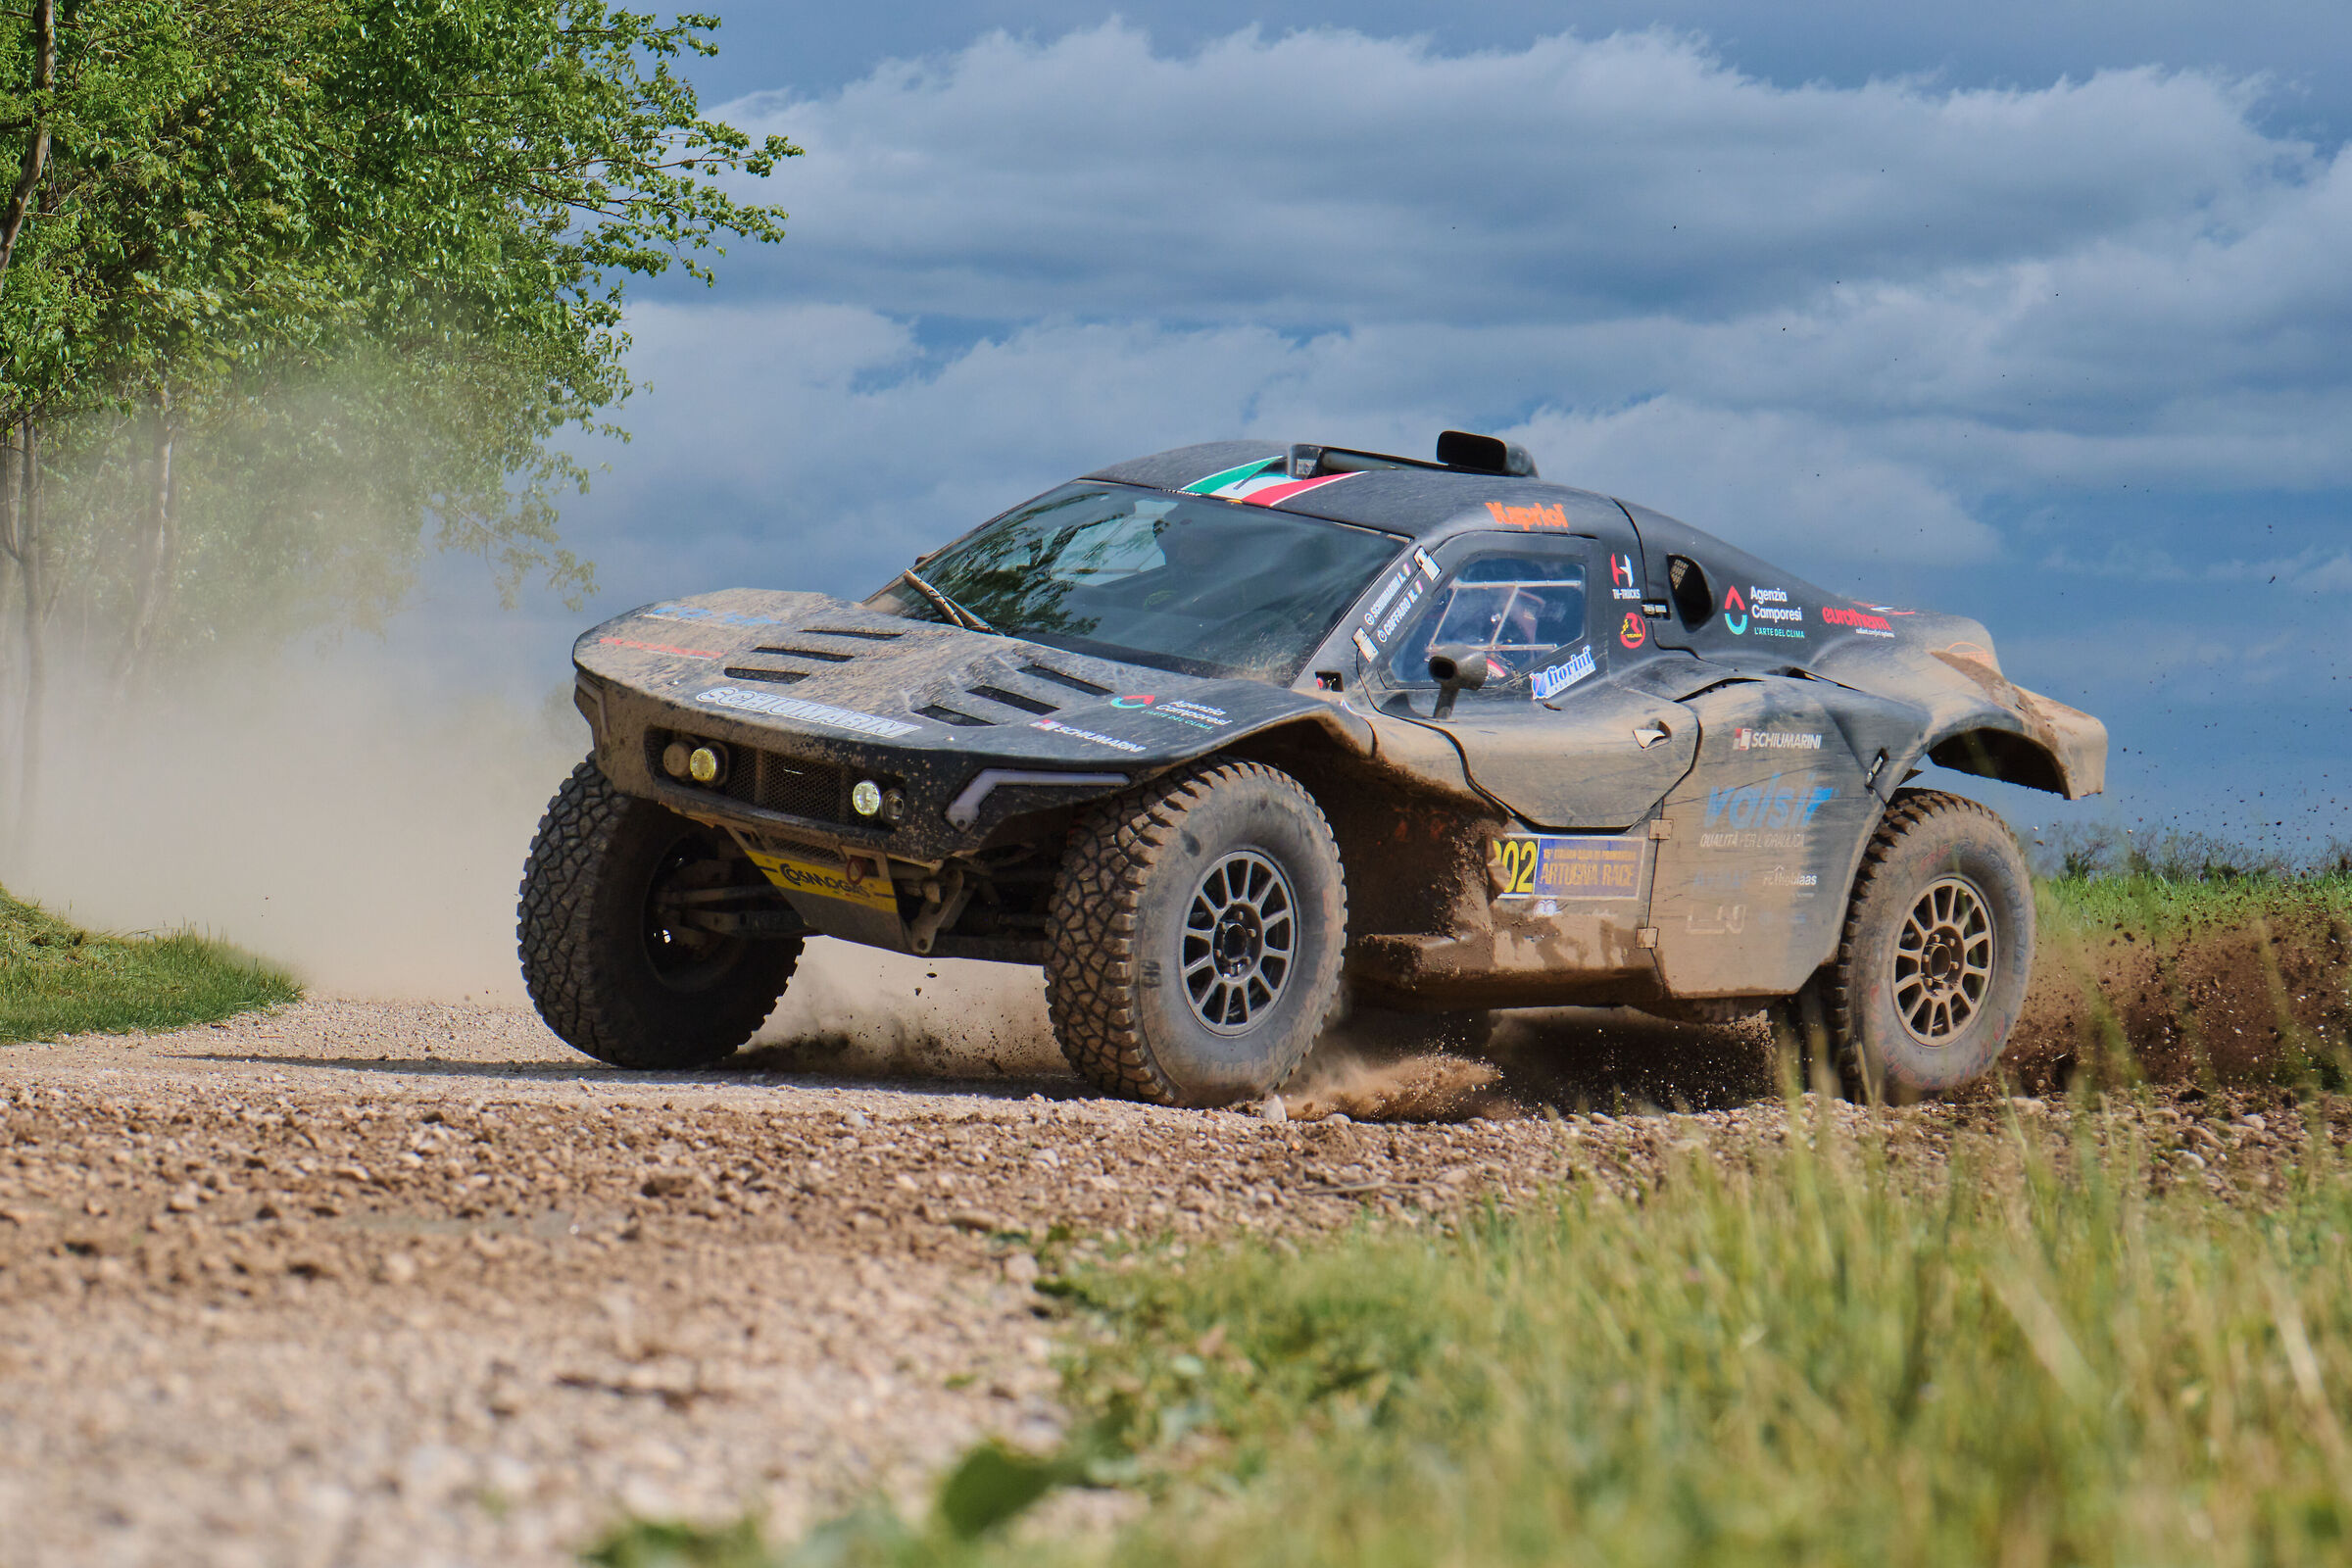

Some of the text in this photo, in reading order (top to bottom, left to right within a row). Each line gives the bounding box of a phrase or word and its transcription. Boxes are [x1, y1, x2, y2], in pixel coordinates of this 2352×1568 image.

[1612, 588, 1641, 600] TH-TRUCKS
[1750, 586, 1788, 604] Agenzia
[1384, 596, 1411, 636] COFFARO
[1751, 605, 1802, 622] Camporesi
[1822, 606, 1891, 630] eurotherm
[1754, 627, 1804, 638] L'ARTE DEL CLIMA
[1547, 646, 1592, 686] fiorini
[1155, 704, 1233, 726] Camporesi
[1168, 700, 1226, 715] Agenzia
[1054, 725, 1147, 753] SCHIUMARINI
[1750, 732, 1822, 750] SCHIUMARINI
[1703, 772, 1834, 830] valsir
[1493, 840, 1538, 893] 02
[1539, 862, 1635, 886] ARTUGNA RACE
